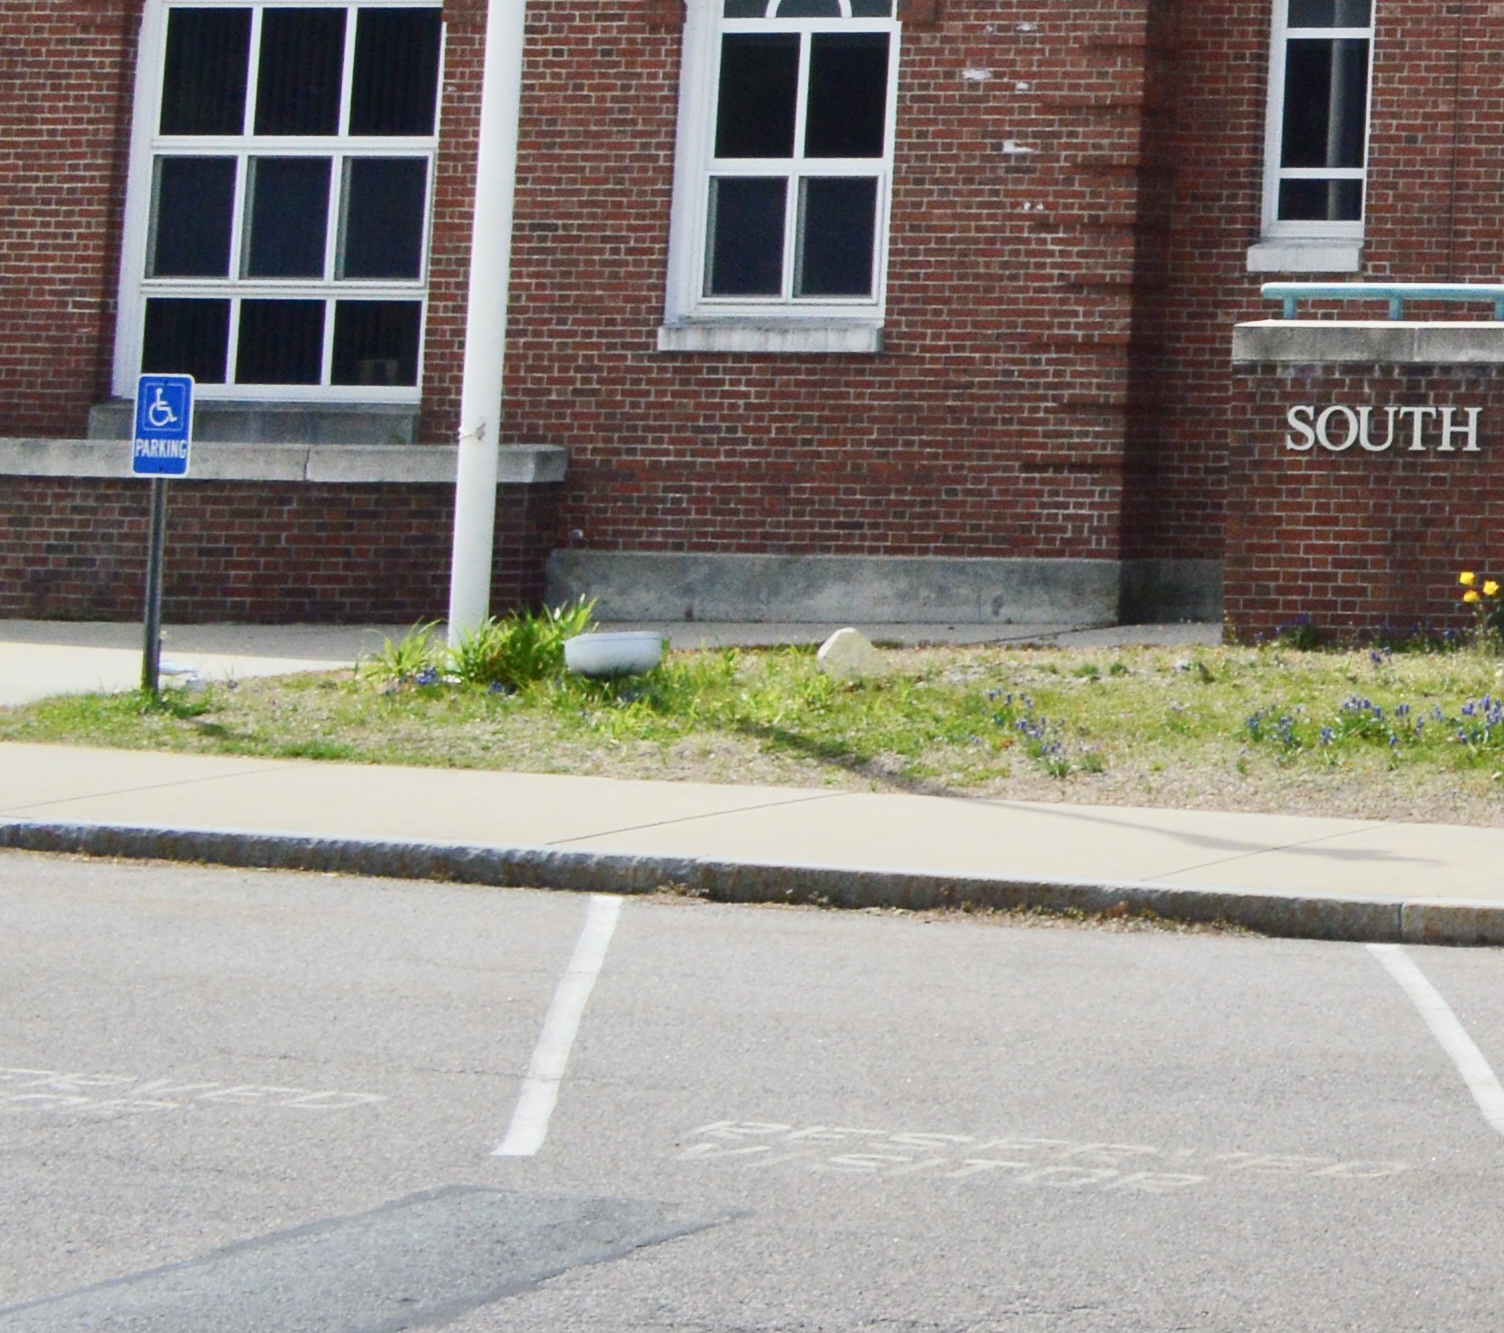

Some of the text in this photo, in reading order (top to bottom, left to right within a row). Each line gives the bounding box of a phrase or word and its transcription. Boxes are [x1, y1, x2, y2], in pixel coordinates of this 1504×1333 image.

[135, 438, 188, 459] PARKING
[1285, 403, 1481, 453] SOUTH
[671, 1142, 1210, 1193] VISITOR
